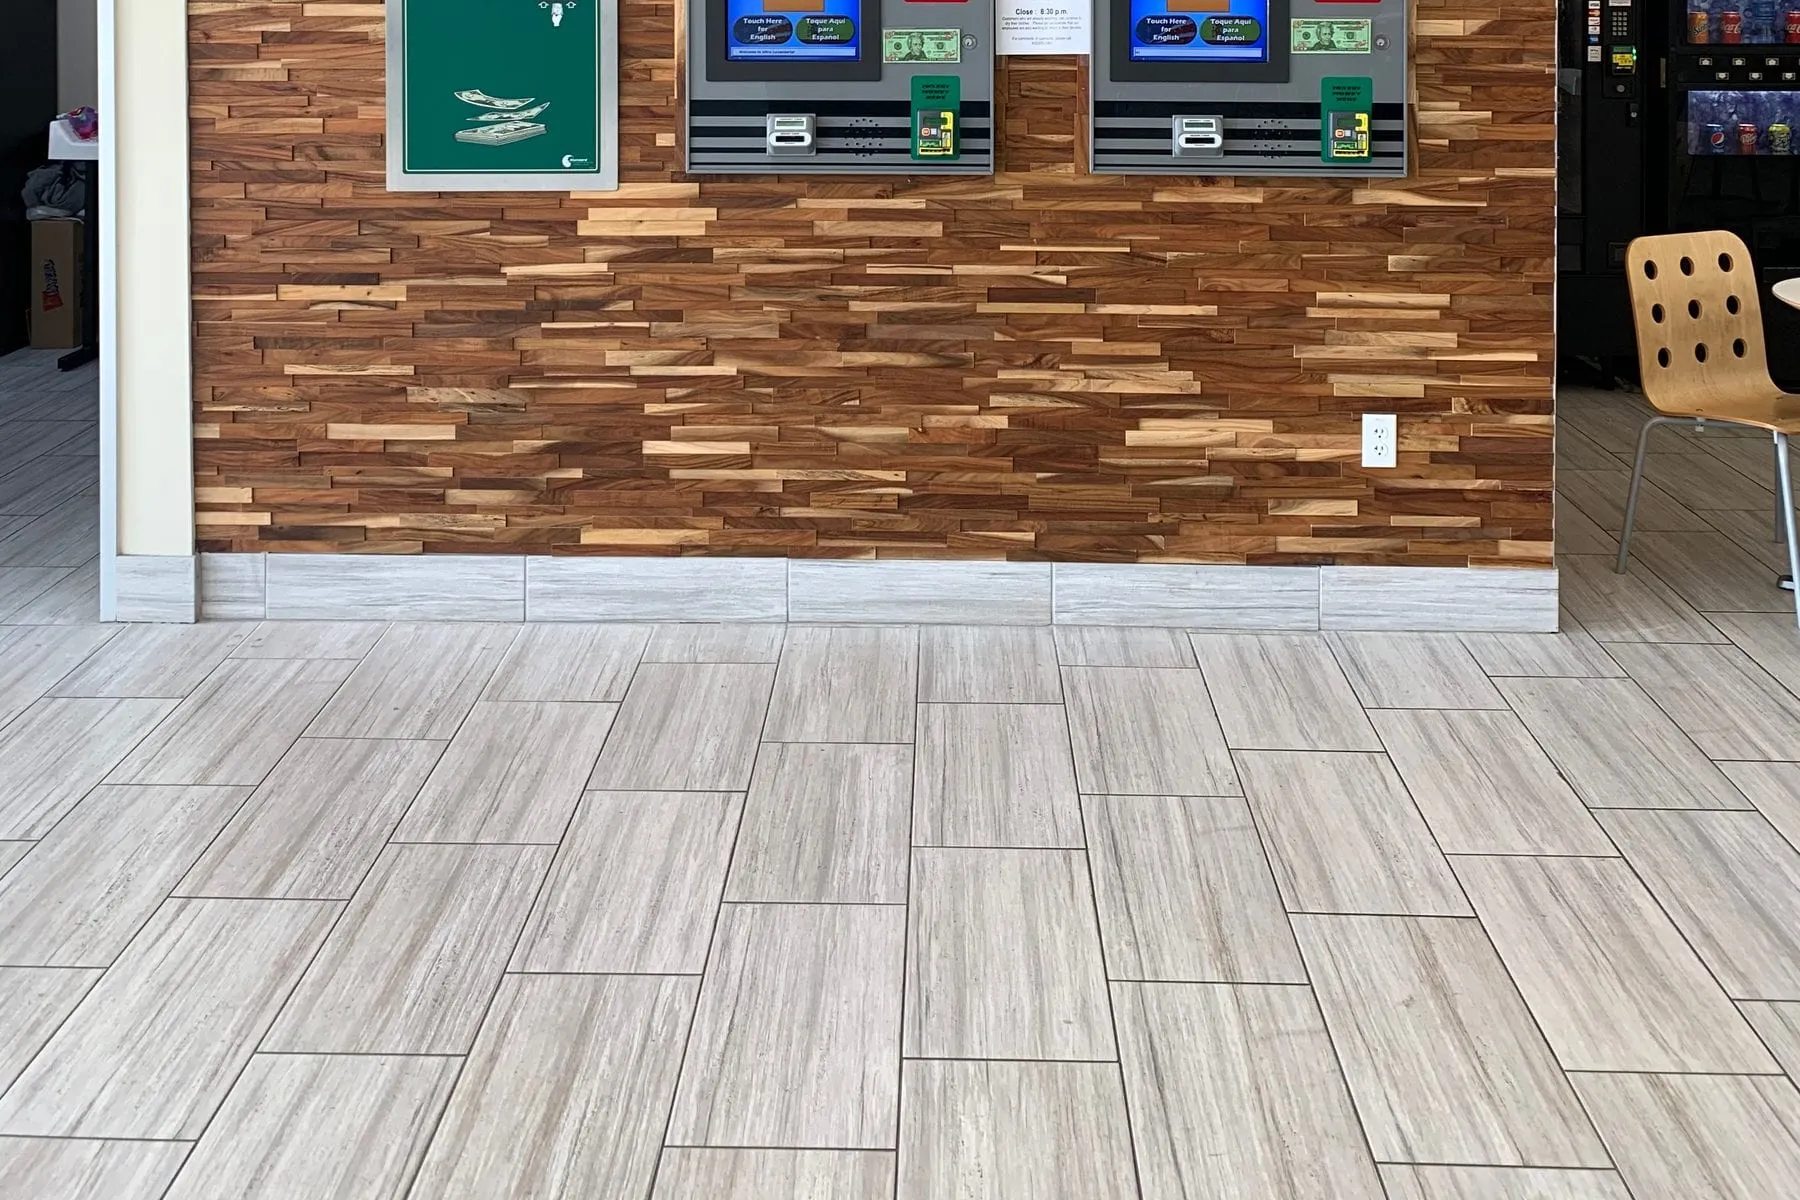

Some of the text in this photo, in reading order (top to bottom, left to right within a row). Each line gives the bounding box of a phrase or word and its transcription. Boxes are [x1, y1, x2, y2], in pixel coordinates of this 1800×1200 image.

[1015, 8, 1034, 16] Close
[743, 17, 783, 25] Touch Here
[806, 17, 828, 26] Toque
[1146, 17, 1187, 25] Touch Here
[1210, 18, 1233, 27] Toque
[757, 25, 769, 33] for
[817, 26, 834, 34] para
[1222, 27, 1239, 35] para
[750, 33, 776, 42] English
[1153, 33, 1180, 42] English
